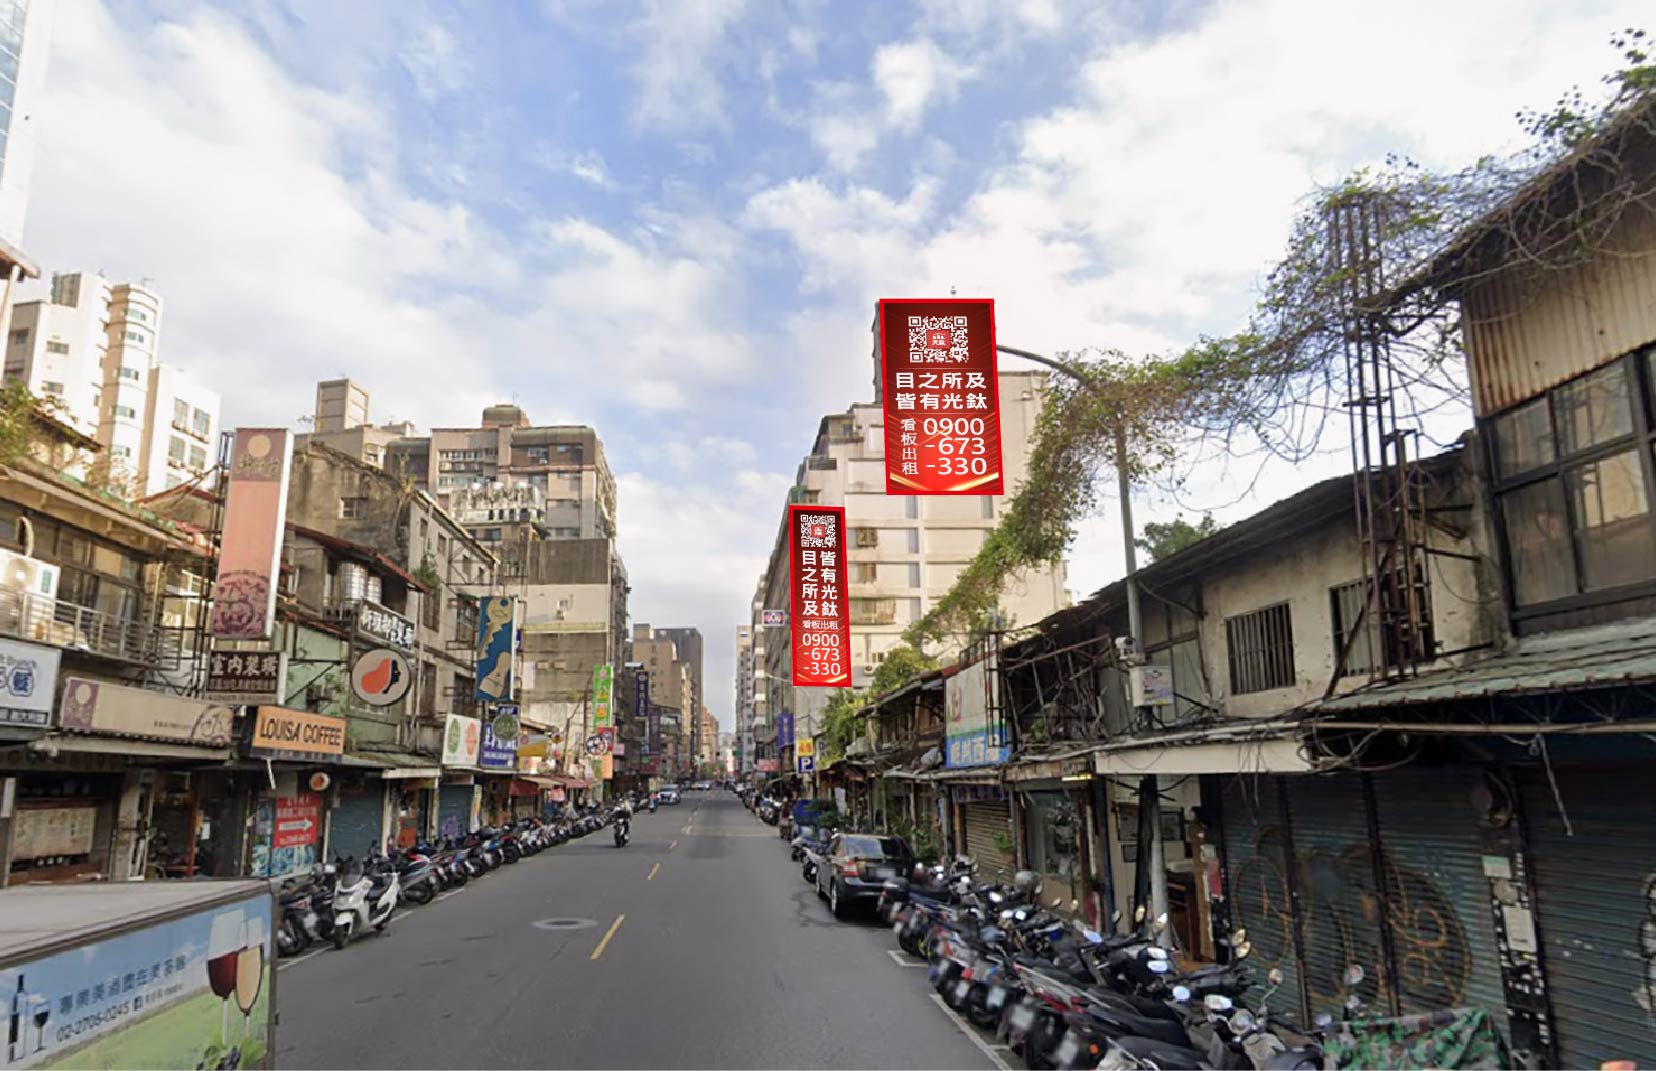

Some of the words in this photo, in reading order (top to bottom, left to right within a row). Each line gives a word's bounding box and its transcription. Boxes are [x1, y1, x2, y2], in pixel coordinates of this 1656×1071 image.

[895, 372, 986, 389] 目之所及
[895, 392, 988, 410] 皆有光鈦
[923, 417, 985, 436] 0900
[900, 418, 919, 475] 看板出租
[925, 437, 986, 455] -673
[925, 457, 987, 476] -330
[801, 550, 819, 616] 目之所及
[820, 551, 838, 617] 皆有光鈦
[802, 620, 839, 630] 看板出租
[802, 633, 839, 647] 0900
[803, 647, 840, 661] -673
[803, 662, 841, 676] -330
[260, 716, 301, 742] LOUISA
[304, 723, 342, 746] COFFEE
[801, 757, 811, 772] P
